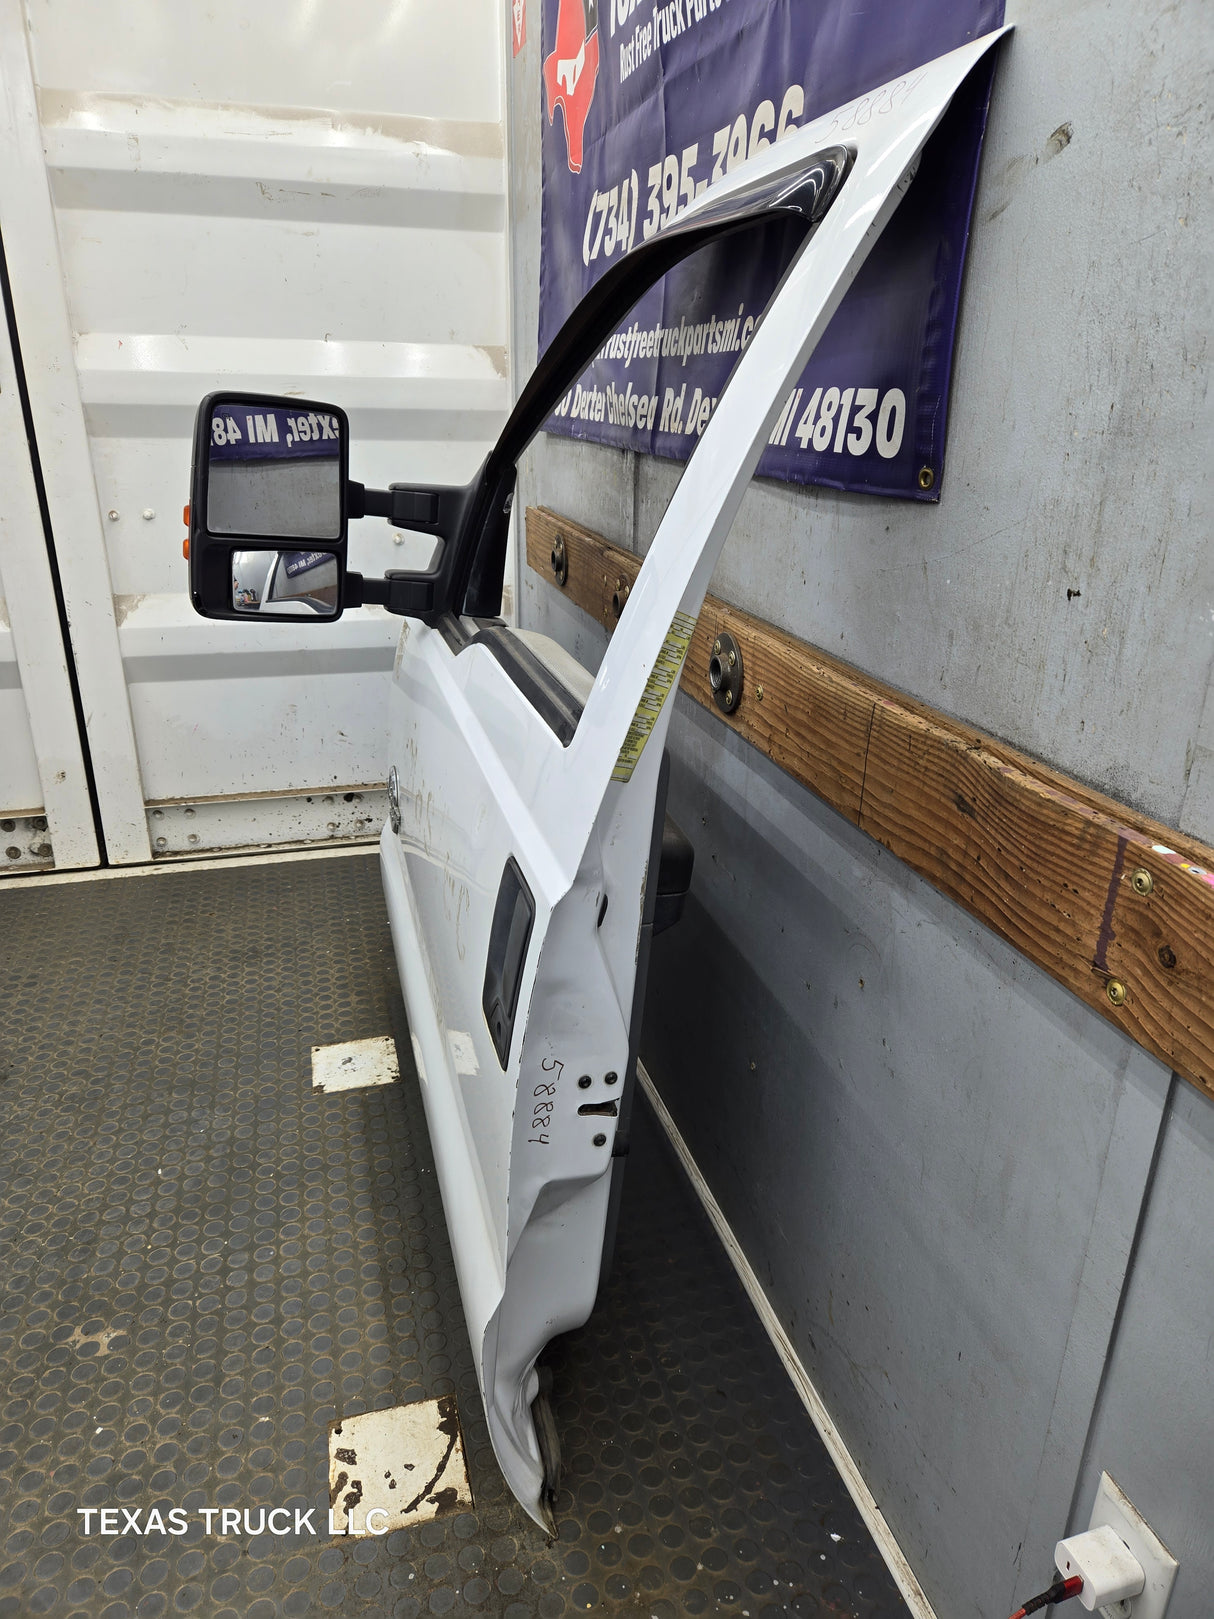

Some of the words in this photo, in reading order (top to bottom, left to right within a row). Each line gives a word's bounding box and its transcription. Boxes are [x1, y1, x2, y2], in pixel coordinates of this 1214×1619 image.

[619, 34, 635, 83] Rust
[635, 21, 652, 68] Free
[652, 0, 687, 51] Truck
[582, 168, 639, 267] (734)
[606, 381, 659, 431] Chelsea
[659, 382, 686, 434] Rd.
[684, 387, 718, 436] De
[795, 386, 906, 459] 48130
[527, 1057, 565, 1145] 58884
